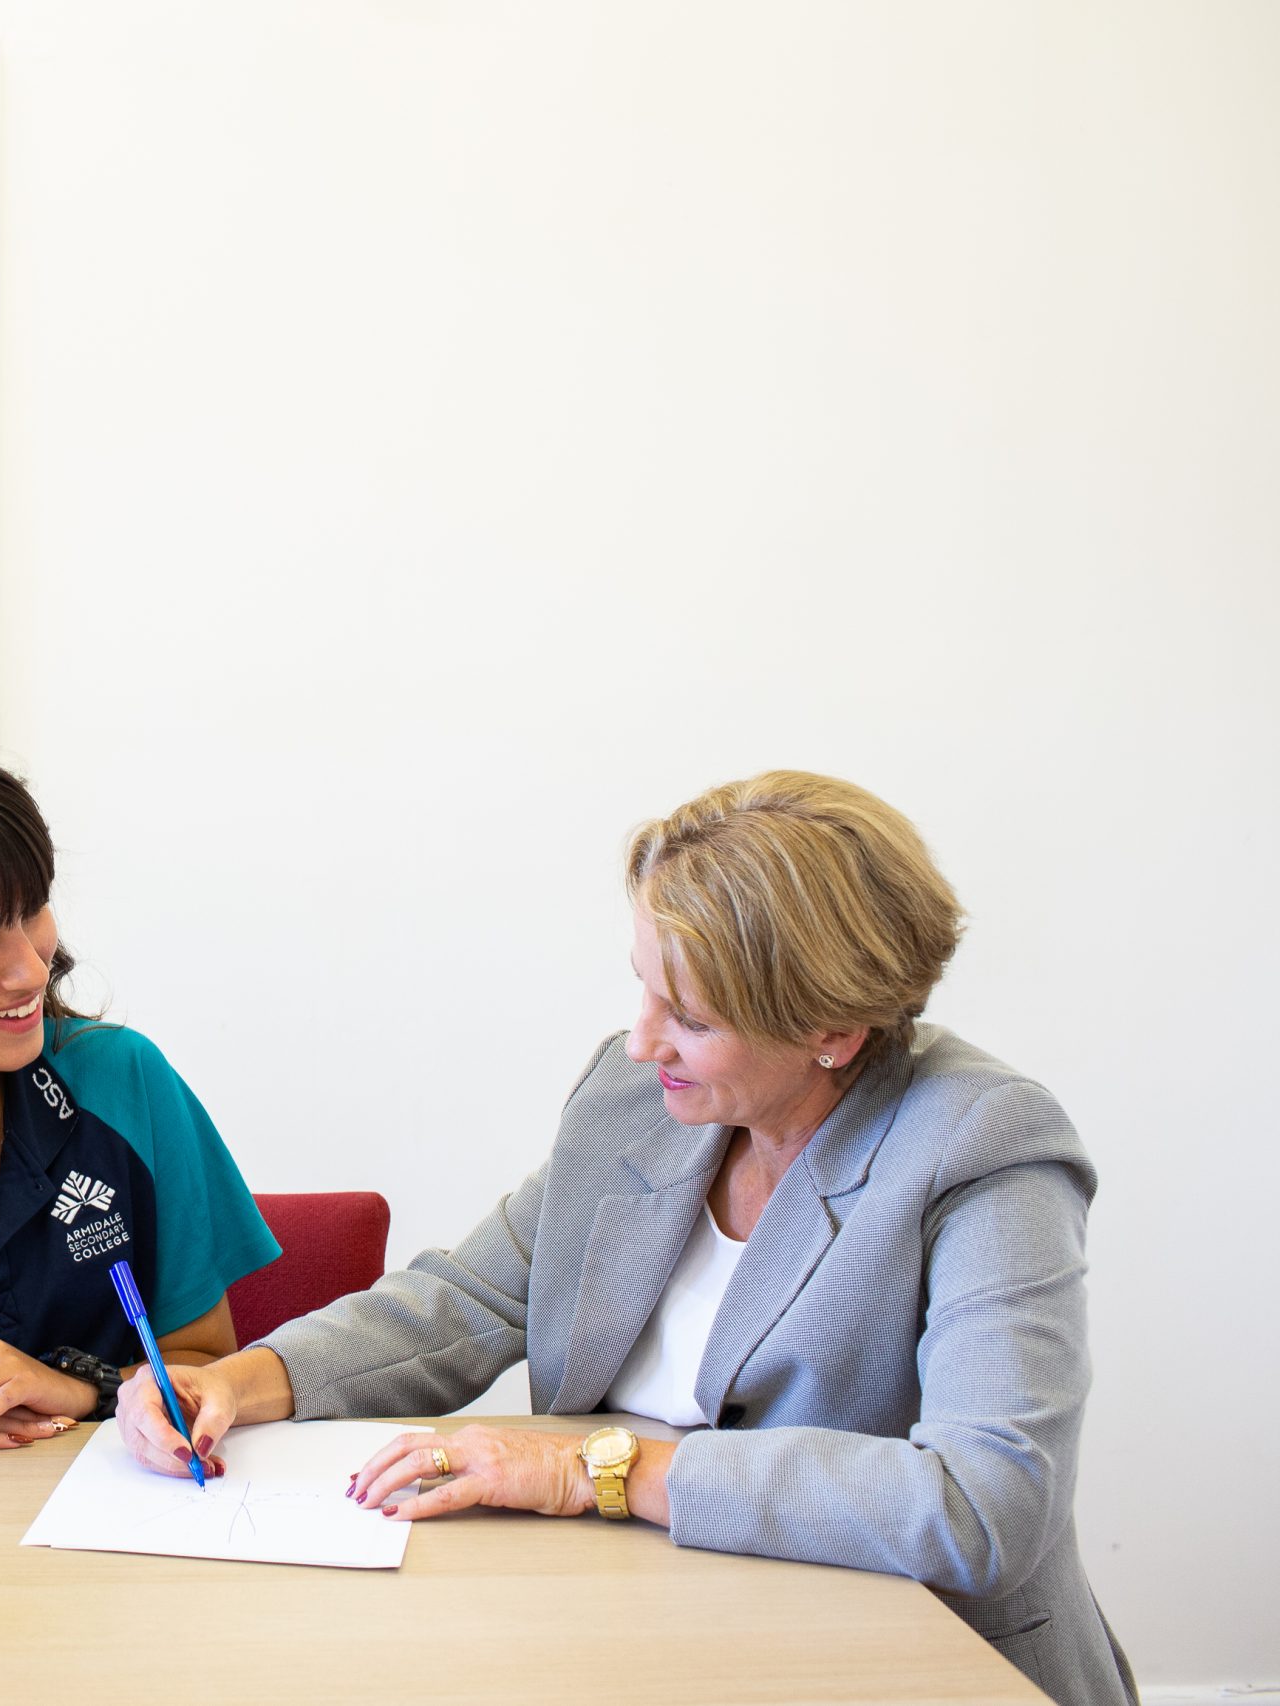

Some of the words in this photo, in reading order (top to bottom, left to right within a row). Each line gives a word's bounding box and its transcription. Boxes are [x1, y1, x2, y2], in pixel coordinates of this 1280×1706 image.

[31, 1067, 74, 1120] ASC
[66, 1211, 122, 1244] ARMIDALE
[68, 1221, 125, 1253] SECONDARY
[73, 1231, 131, 1262] COLLEGE
